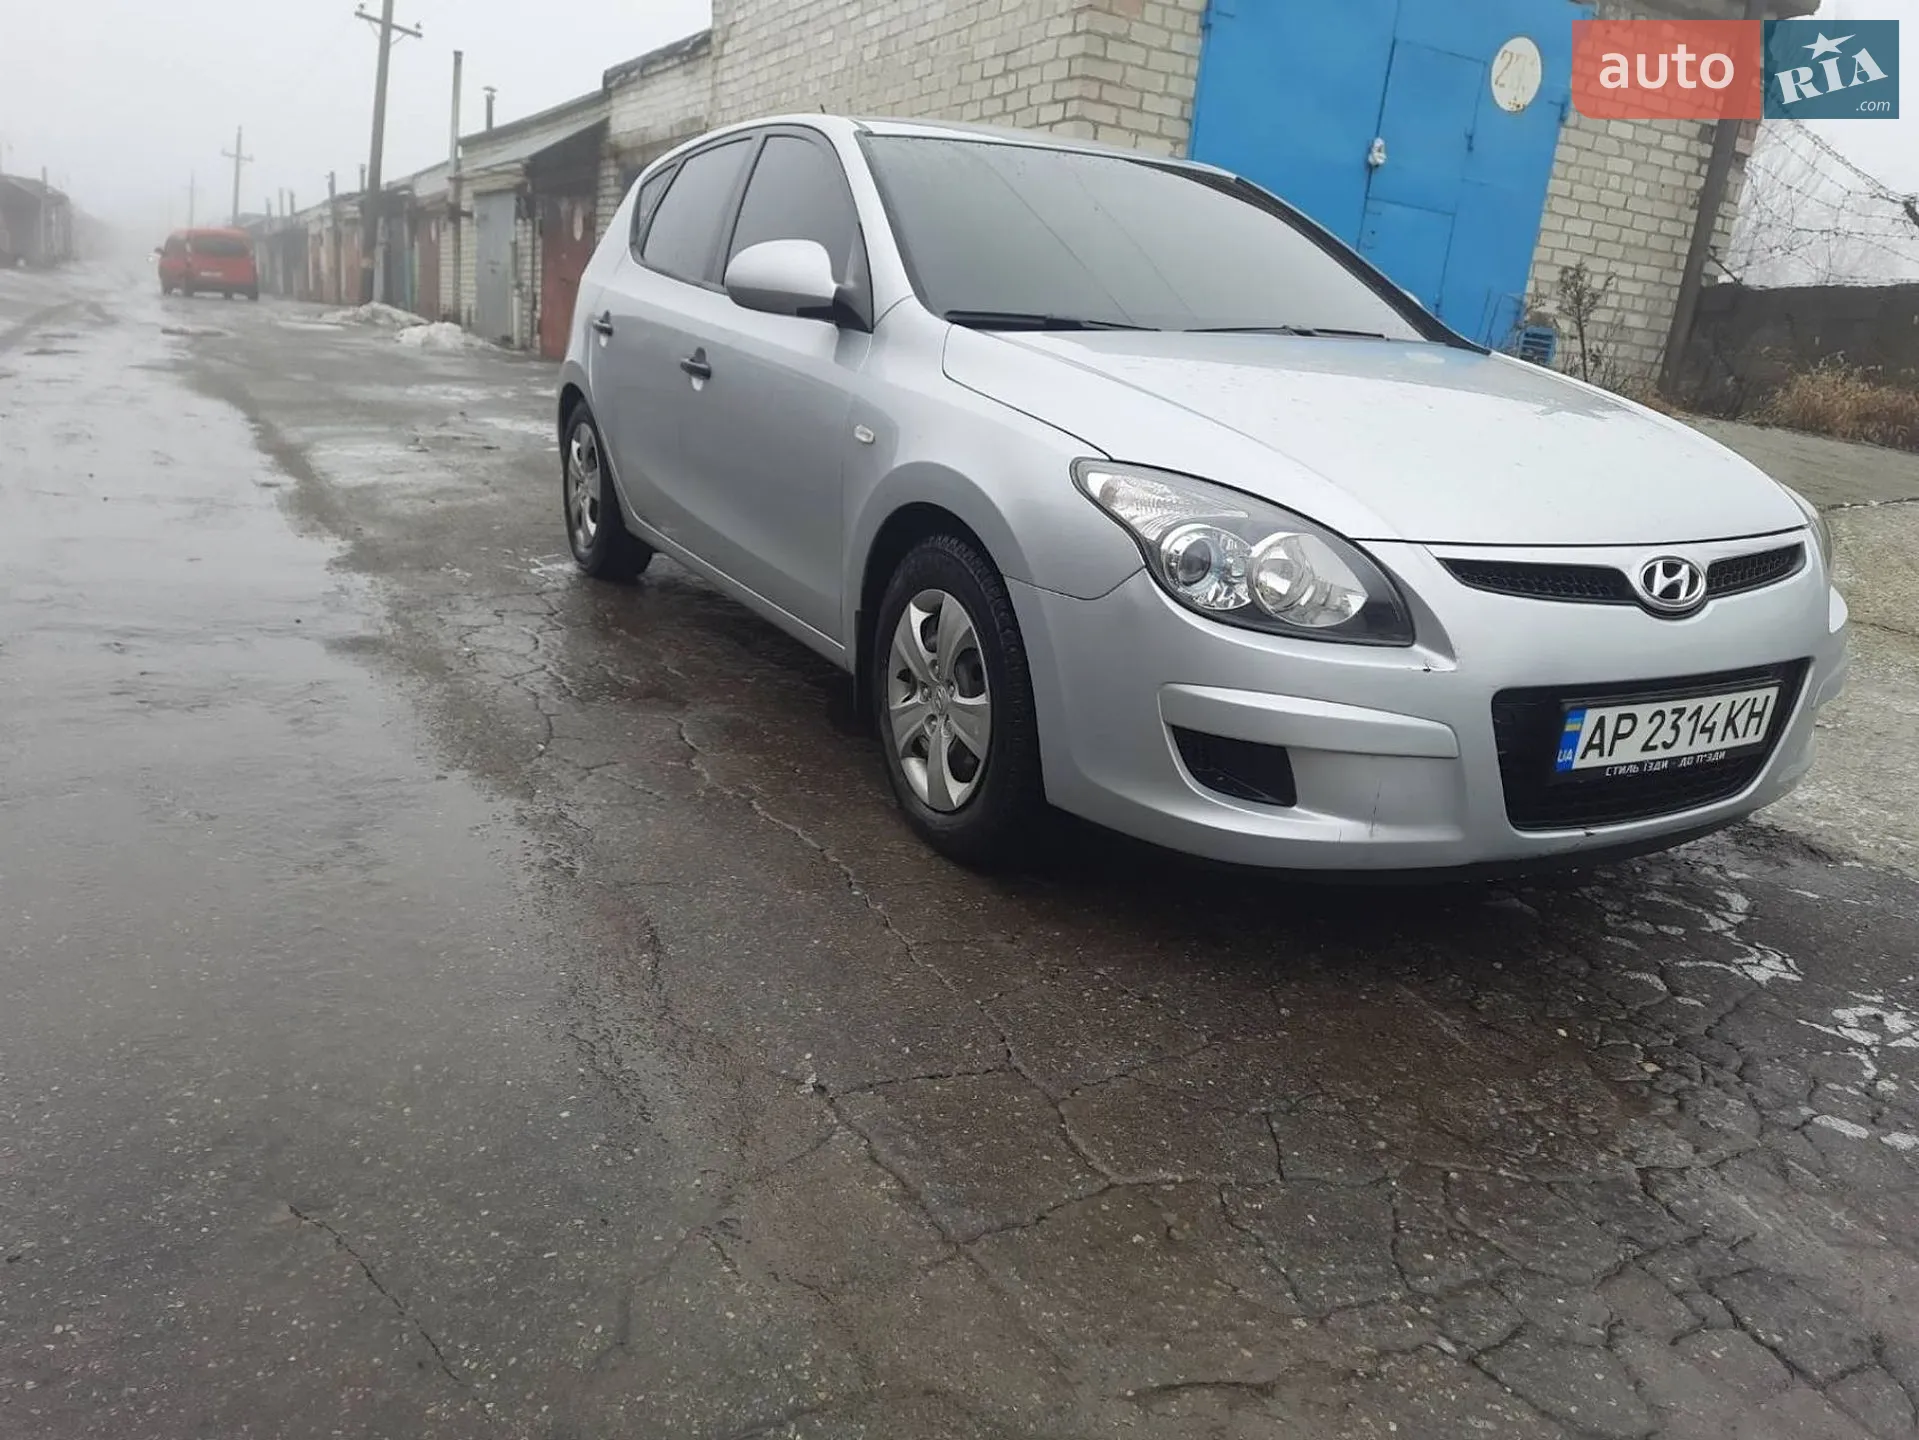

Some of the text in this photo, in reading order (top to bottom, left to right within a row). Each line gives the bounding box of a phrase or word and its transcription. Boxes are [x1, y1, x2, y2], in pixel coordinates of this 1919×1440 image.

[1580, 695, 1770, 760] AP 2314 KH
[1557, 748, 1573, 762] UA
[1605, 765, 1640, 777] СТИЛЬ
